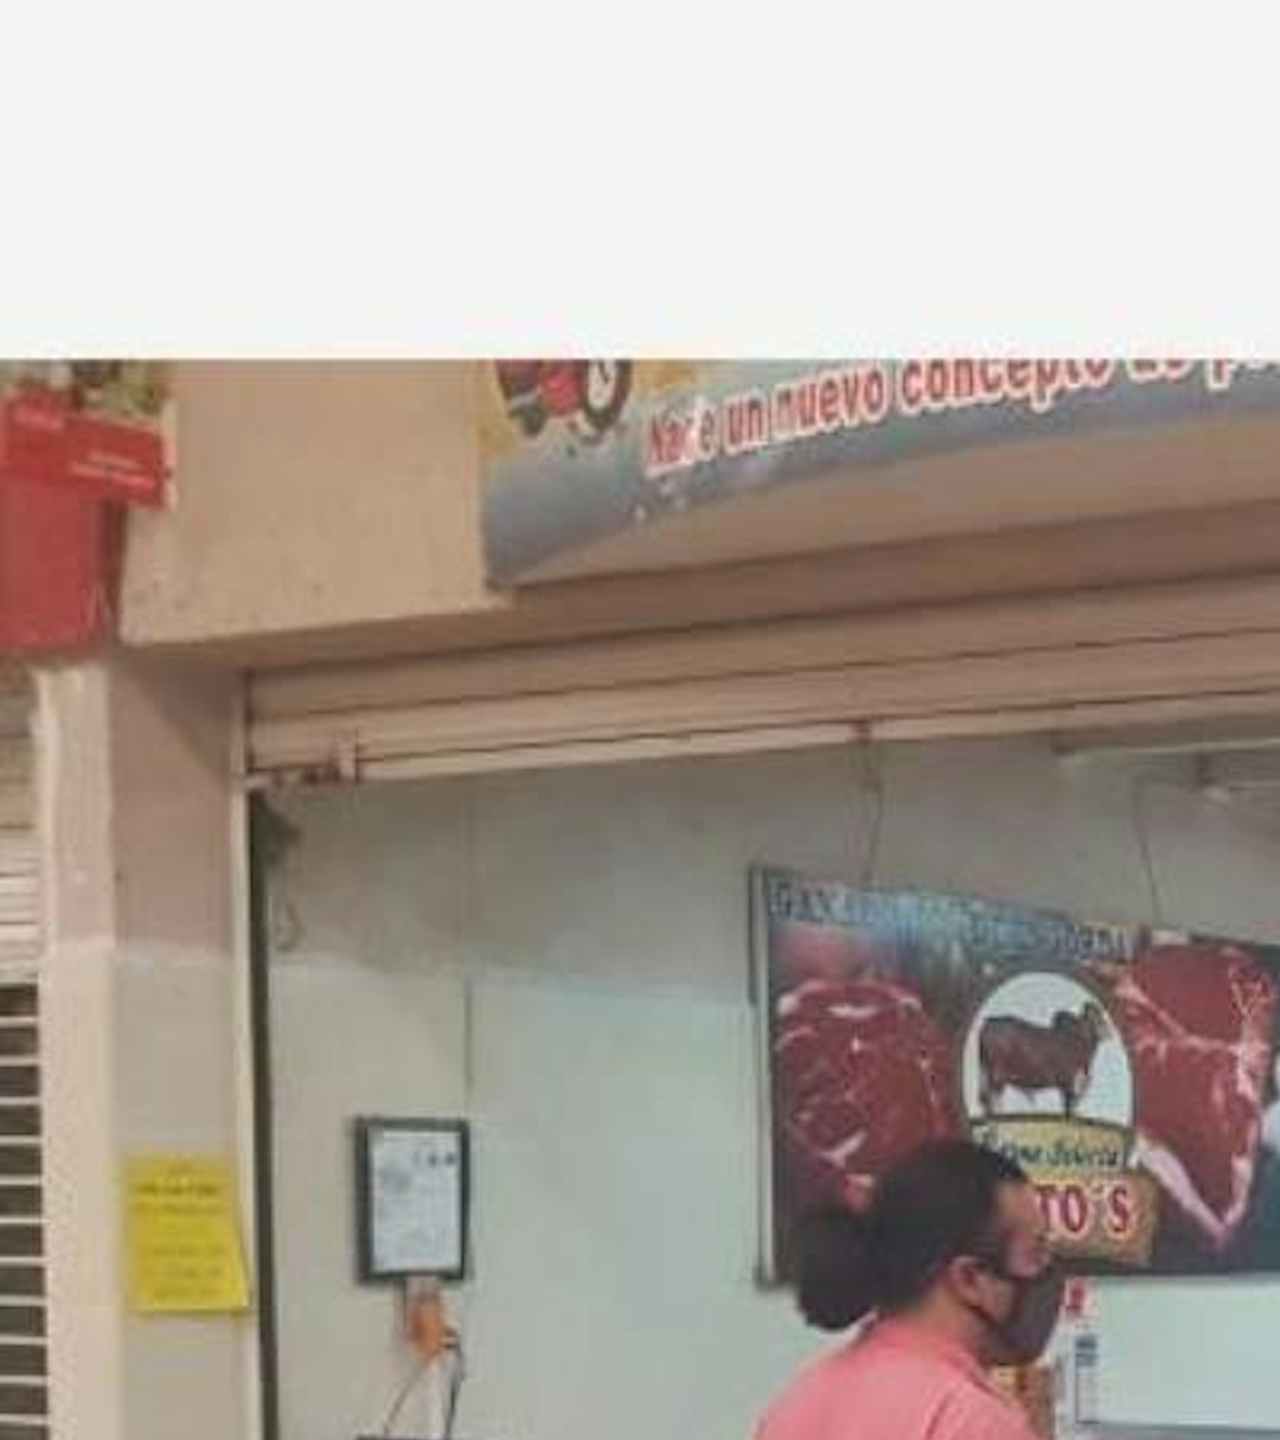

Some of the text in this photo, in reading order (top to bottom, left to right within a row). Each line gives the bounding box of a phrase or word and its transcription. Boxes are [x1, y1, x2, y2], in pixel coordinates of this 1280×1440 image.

[647, 400, 719, 470] Nae
[727, 394, 768, 450] un
[776, 364, 885, 434] nuevo
[1034, 1184, 1130, 1234] TO´S
